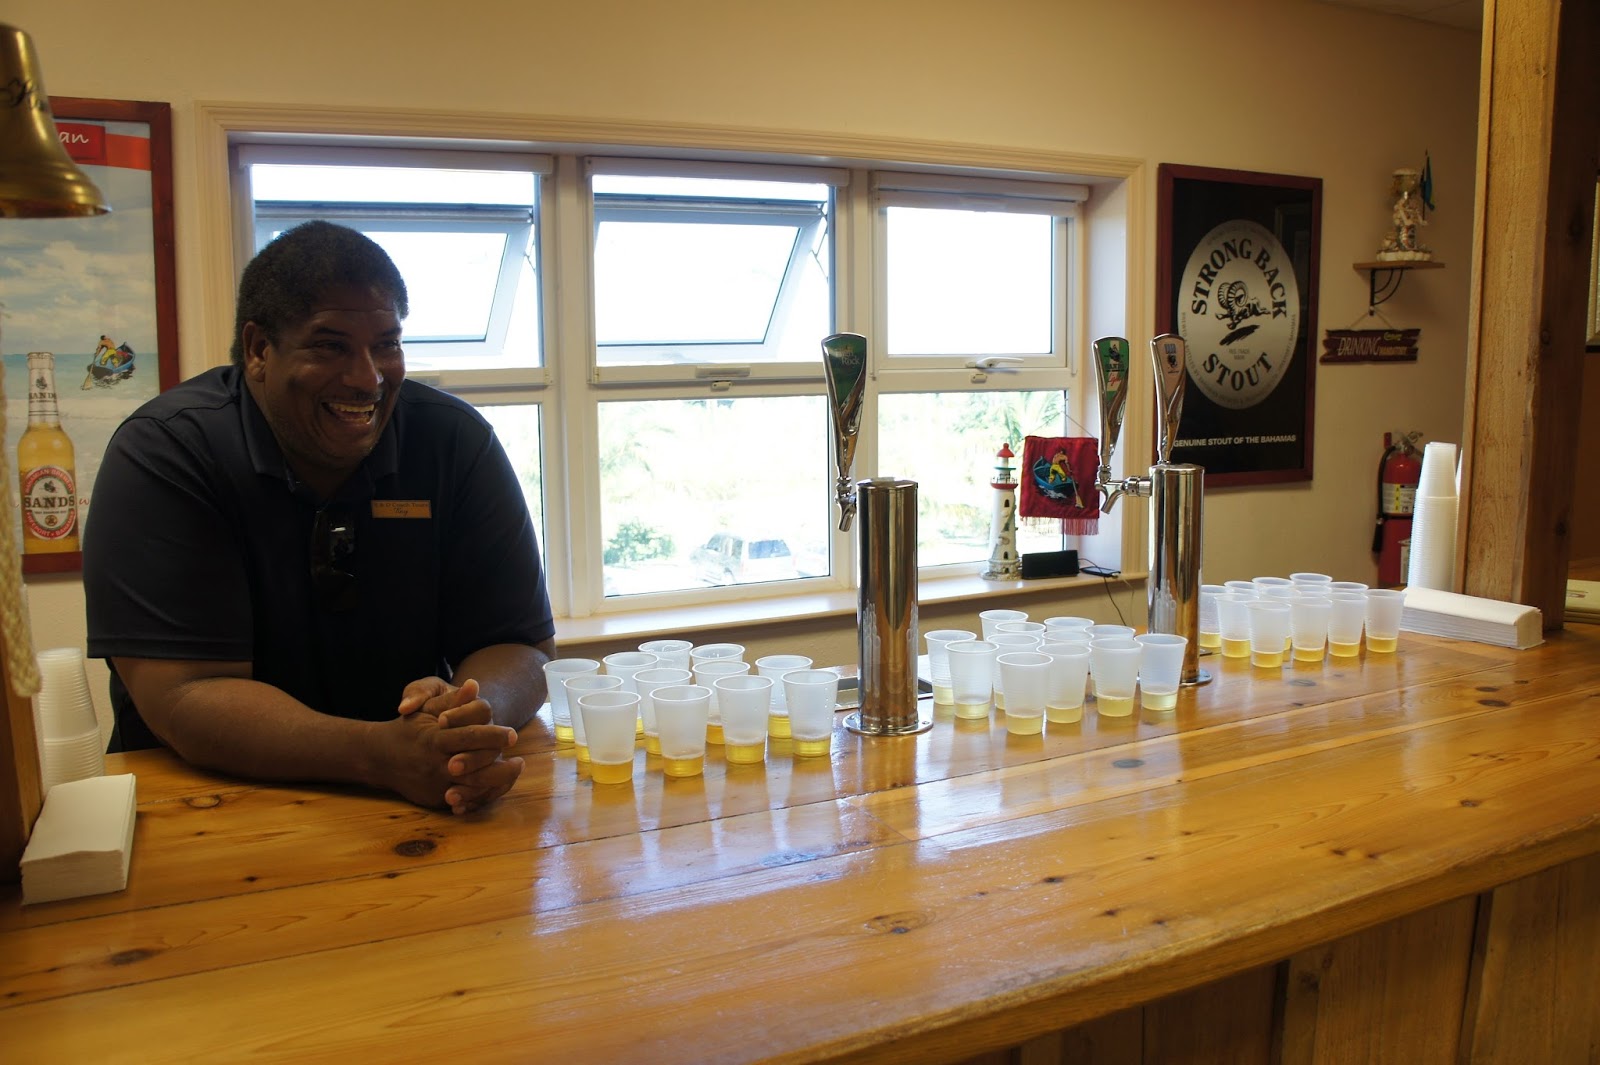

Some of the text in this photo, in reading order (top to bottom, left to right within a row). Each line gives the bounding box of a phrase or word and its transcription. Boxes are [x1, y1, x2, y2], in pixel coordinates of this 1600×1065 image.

[1191, 238, 1287, 320] STRONG BACK
[1337, 336, 1381, 356] DRINKING
[1202, 352, 1272, 391] STOUT
[1173, 434, 1297, 447] GENUINE STOUT OF THE BAHAMAS
[24, 495, 75, 508] SANDS
